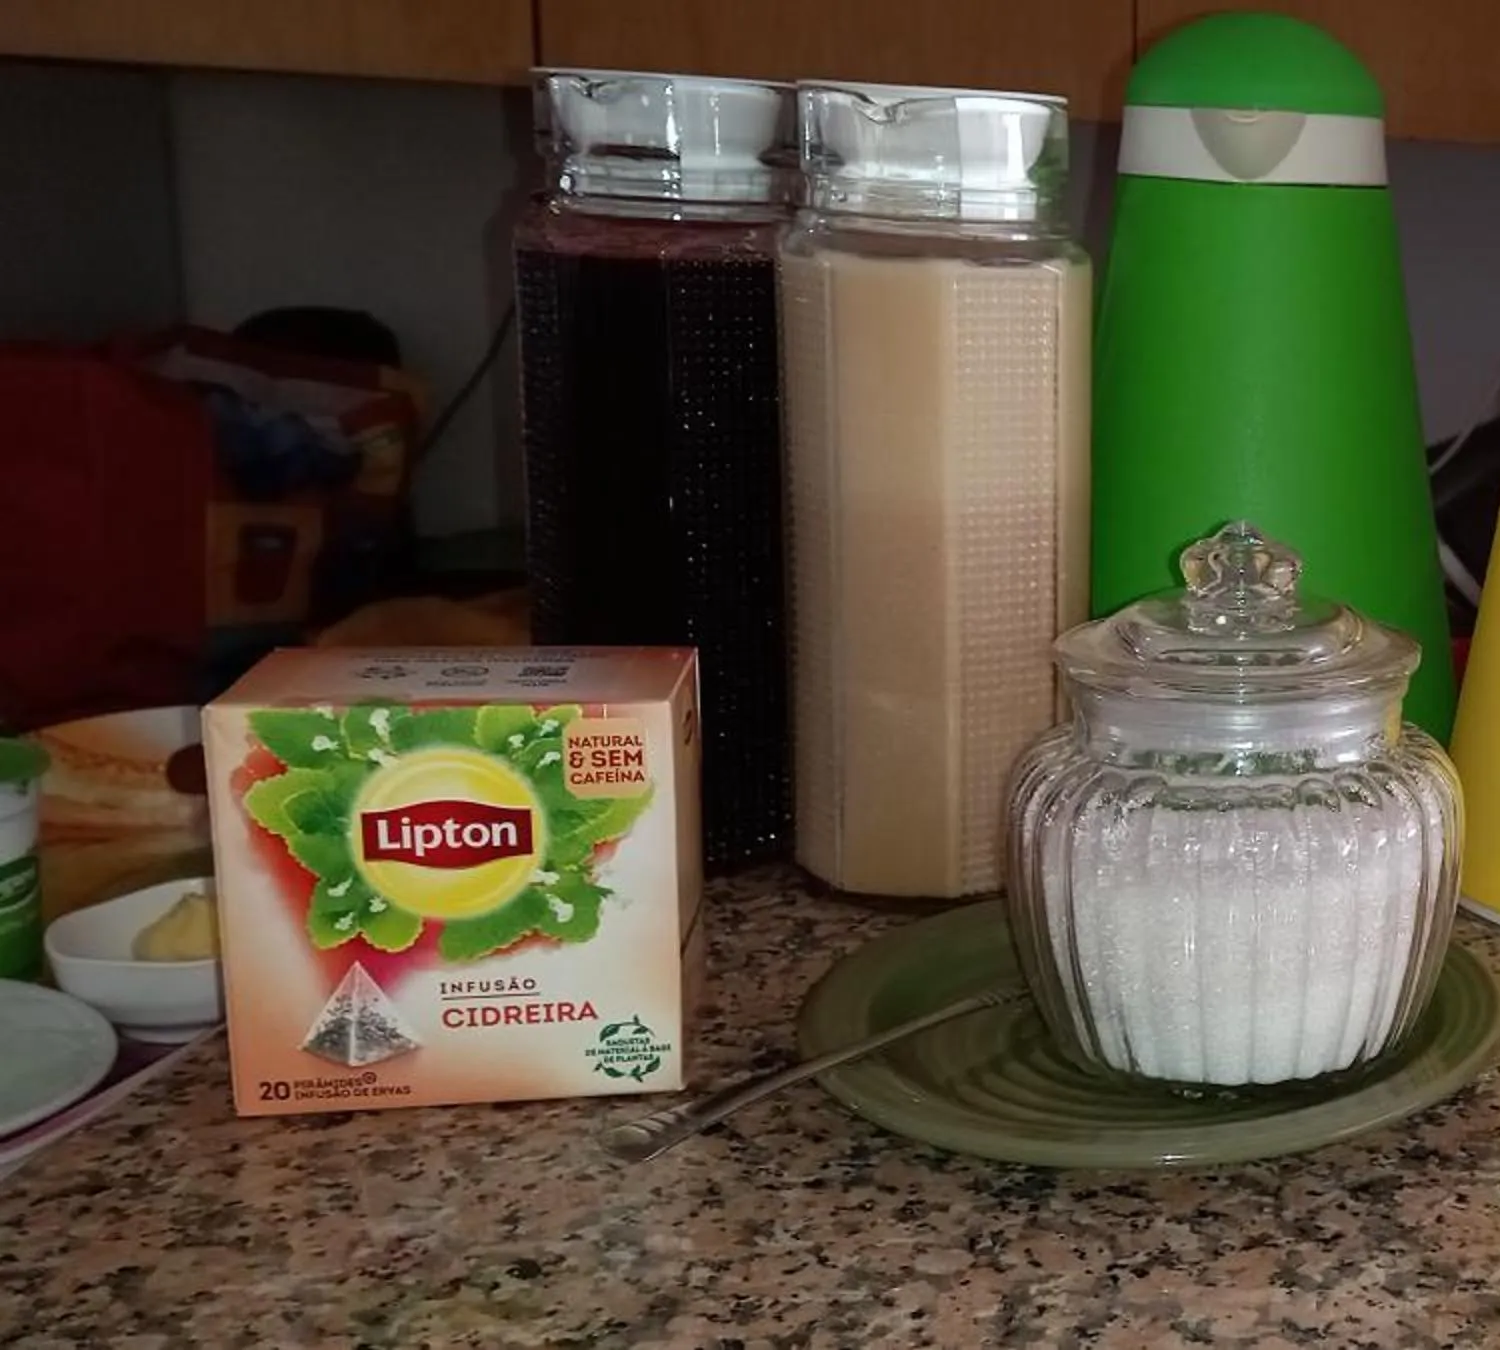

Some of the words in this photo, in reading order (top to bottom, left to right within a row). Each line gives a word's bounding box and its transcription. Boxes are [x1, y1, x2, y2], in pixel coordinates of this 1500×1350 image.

[568, 735, 643, 749] NATURAL
[569, 751, 584, 769] &
[591, 749, 643, 768] SEM
[570, 768, 645, 785] CAFEÍNA
[377, 817, 518, 857] Lipton
[440, 977, 537, 994] INFUSÃO
[442, 1000, 599, 1028] CIDREIRA
[259, 1081, 291, 1101] 20
